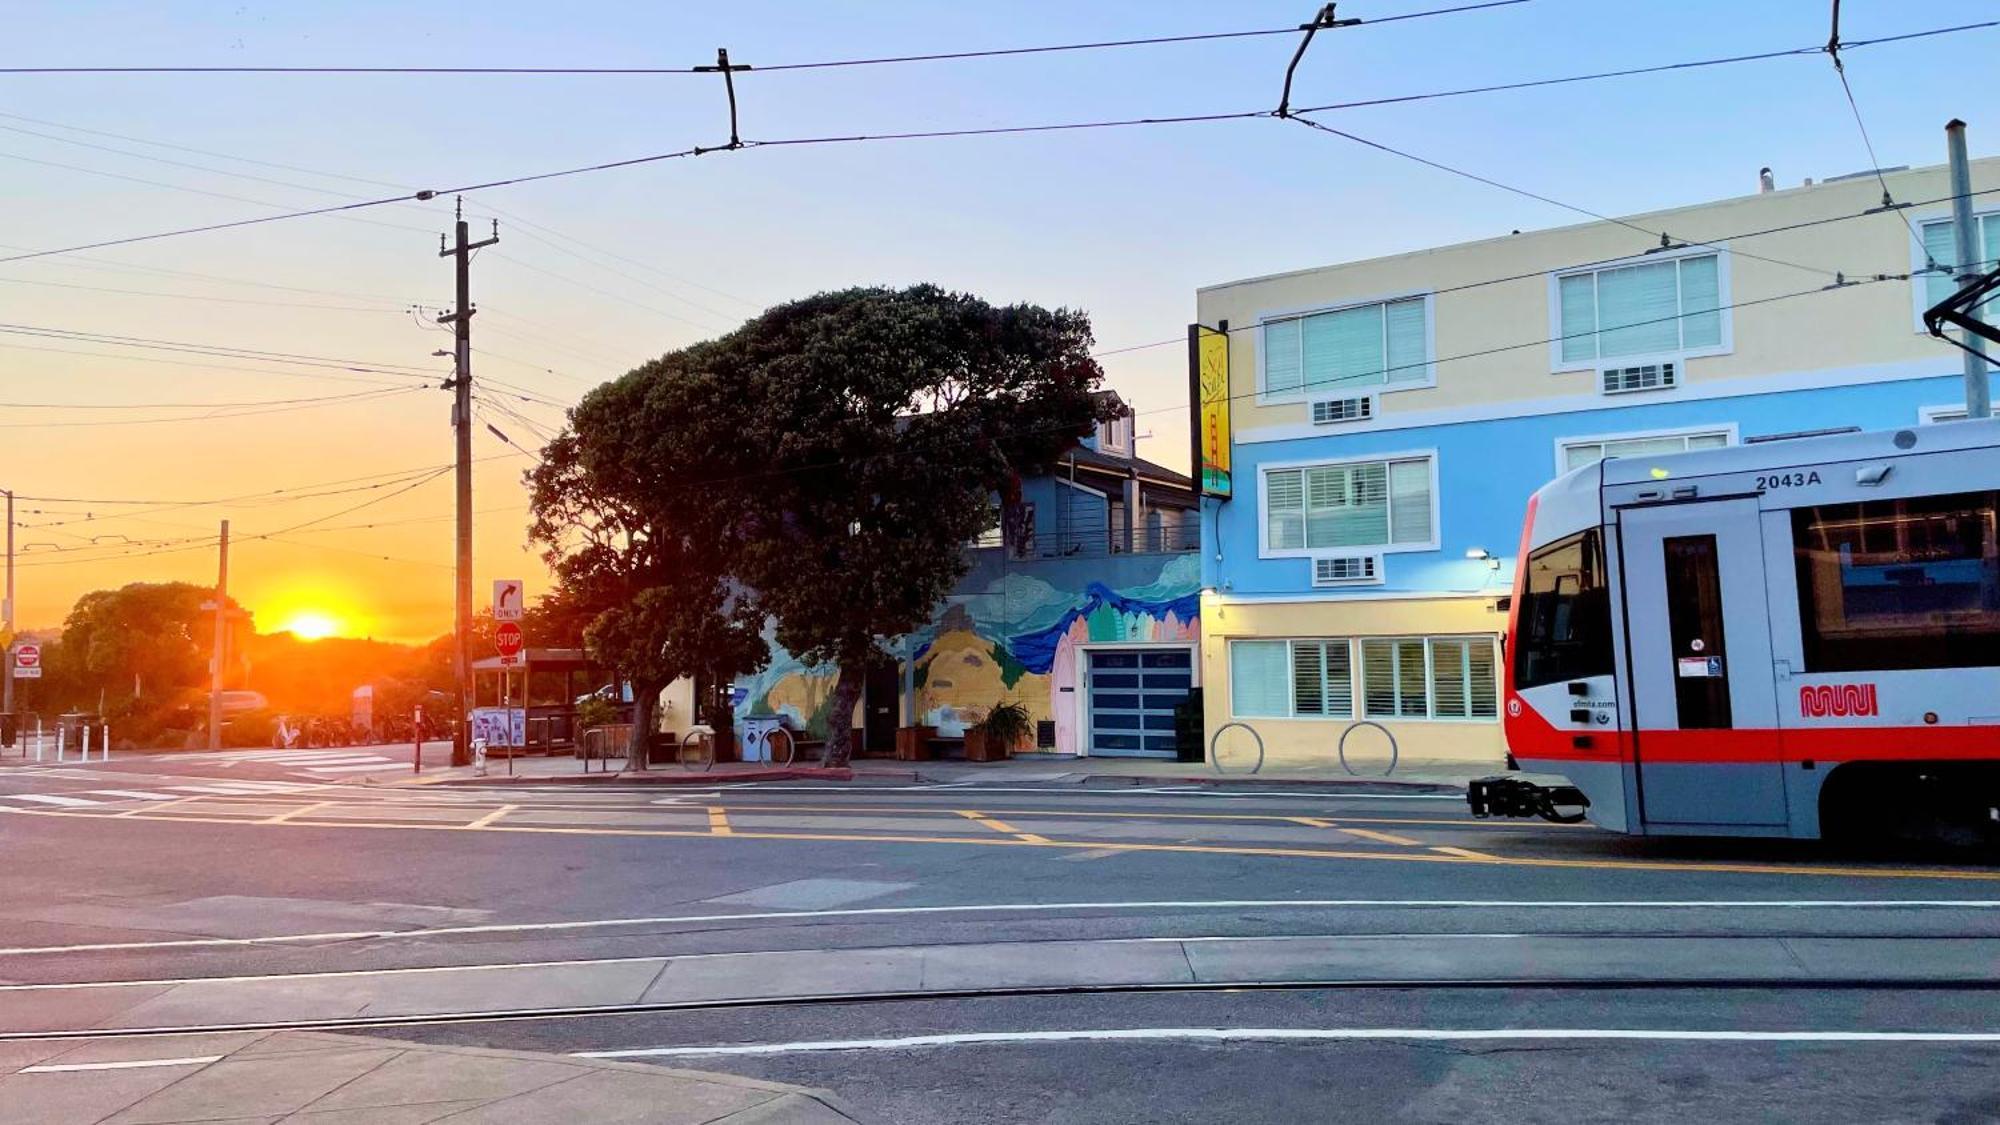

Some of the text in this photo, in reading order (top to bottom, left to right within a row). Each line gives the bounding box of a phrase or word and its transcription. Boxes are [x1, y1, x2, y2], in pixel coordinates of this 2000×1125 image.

[1756, 471, 1822, 490] 2043A
[498, 609, 519, 618] ONLY
[497, 632, 521, 647] STOP
